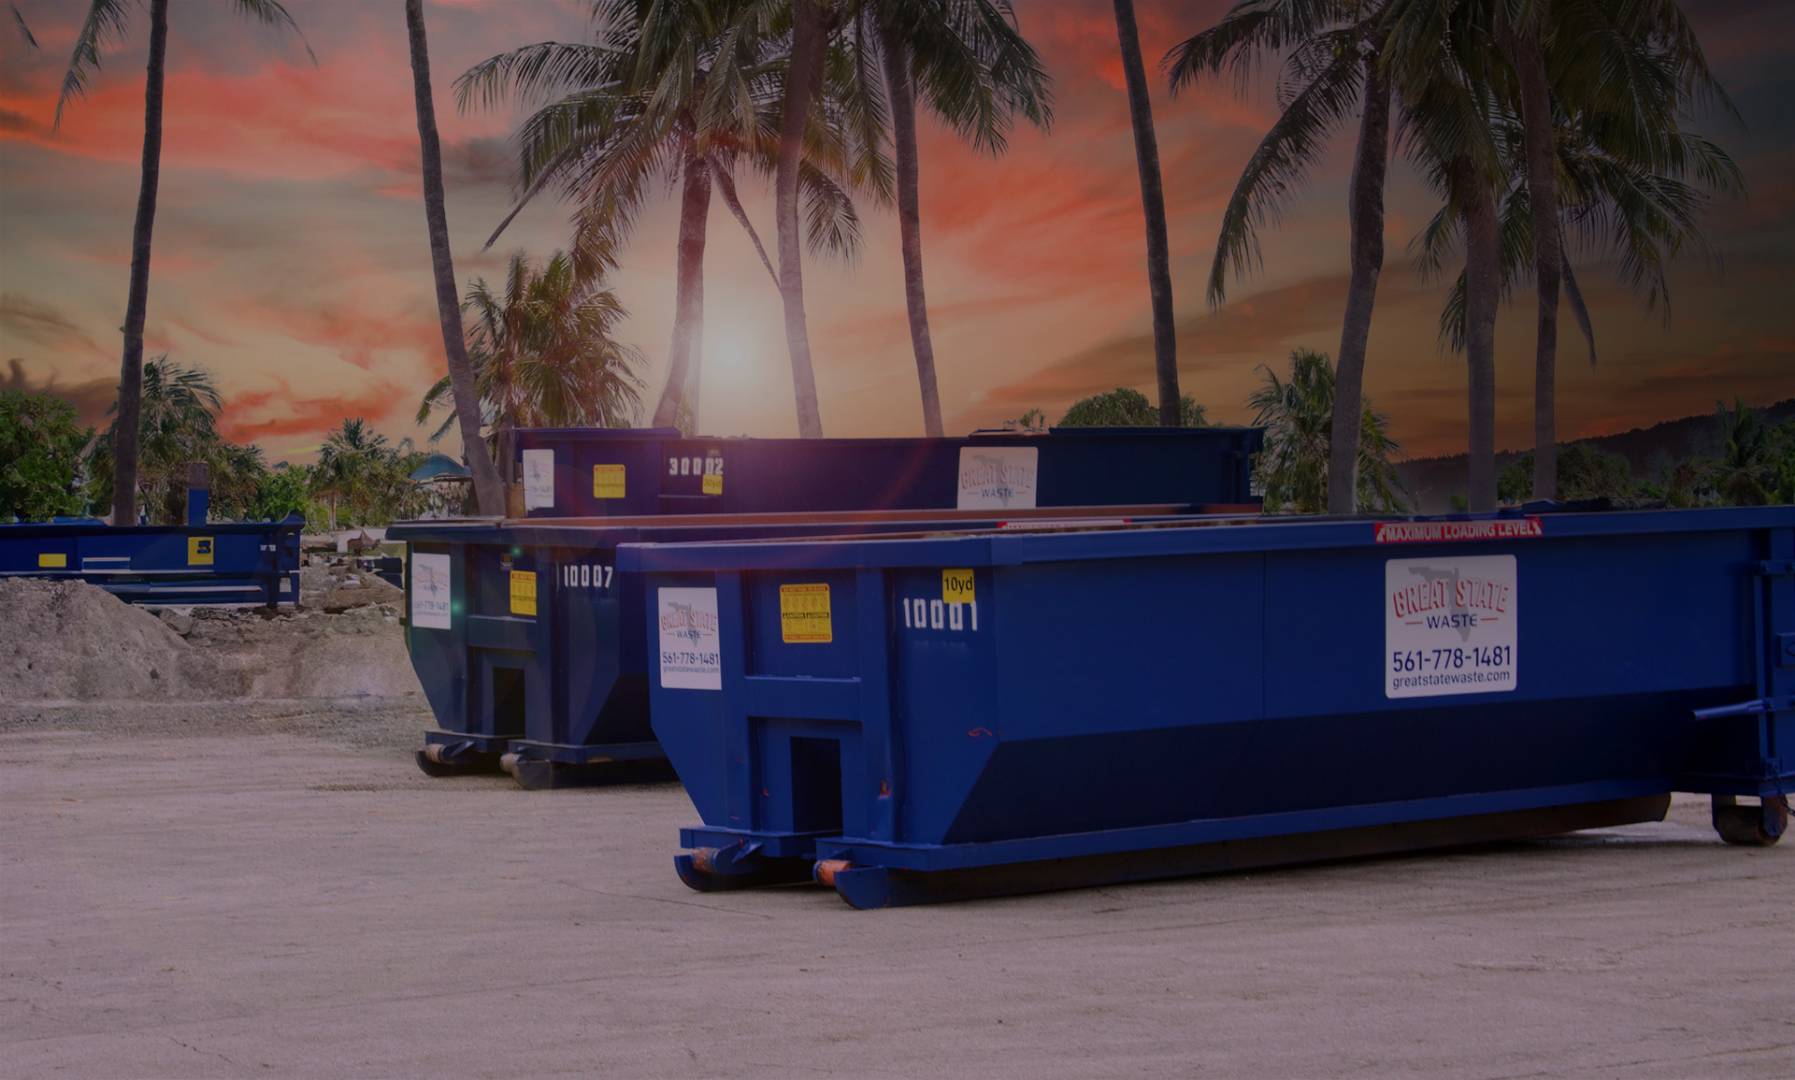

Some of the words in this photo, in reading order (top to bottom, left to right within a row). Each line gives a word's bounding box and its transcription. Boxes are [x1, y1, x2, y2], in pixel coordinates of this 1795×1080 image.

[669, 457, 724, 475] 30002
[982, 487, 1014, 497] WASTE
[1385, 525, 1441, 541] MAXIMUM
[1444, 524, 1494, 539] LOADING
[564, 565, 613, 588] 10007
[944, 576, 973, 594] 10yd
[1393, 579, 1446, 617] GREAT
[1455, 579, 1508, 613] STATE
[903, 598, 977, 631] 10001
[1426, 614, 1477, 629] WASTE
[677, 630, 700, 639] WASTE
[663, 651, 719, 664] 561-778-1481
[1393, 646, 1511, 672] 561-778-1481
[1393, 669, 1510, 690] greatstatewaste.com
